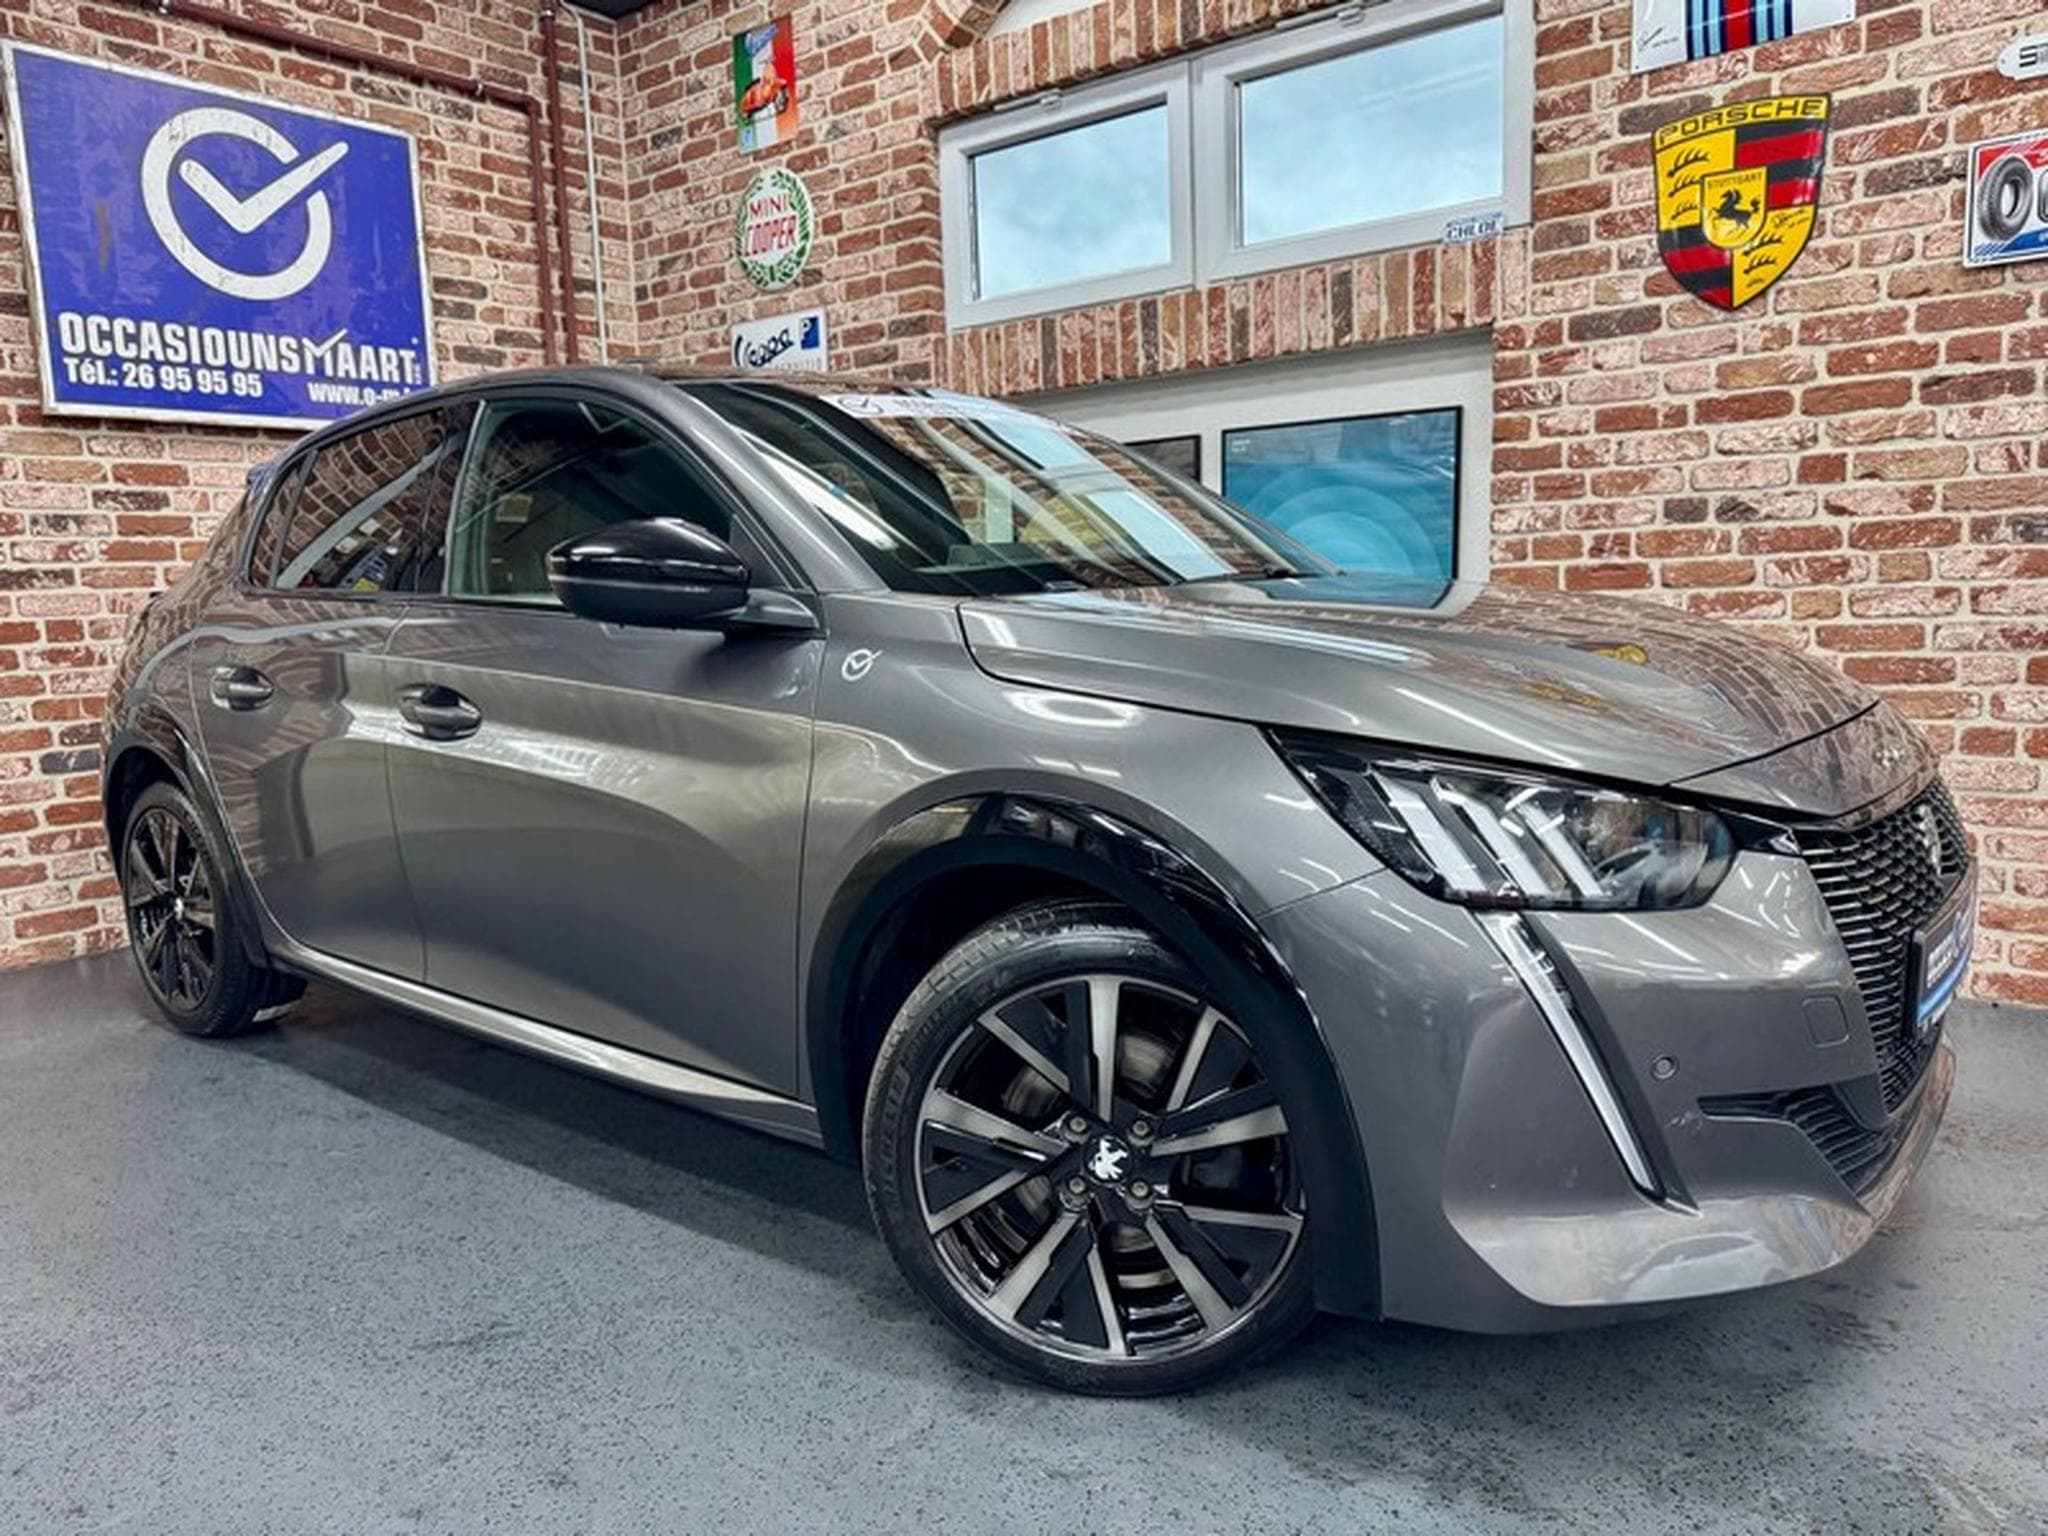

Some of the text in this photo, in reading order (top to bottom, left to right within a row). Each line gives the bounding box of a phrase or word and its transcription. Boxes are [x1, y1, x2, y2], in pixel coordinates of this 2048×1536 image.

[1658, 99, 1823, 146] PORSCHE
[750, 193, 788, 219] MINI
[744, 215, 797, 257] COOPER
[734, 334, 795, 368] Vespa
[63, 357, 263, 398] Tél.: 26 95 95 95
